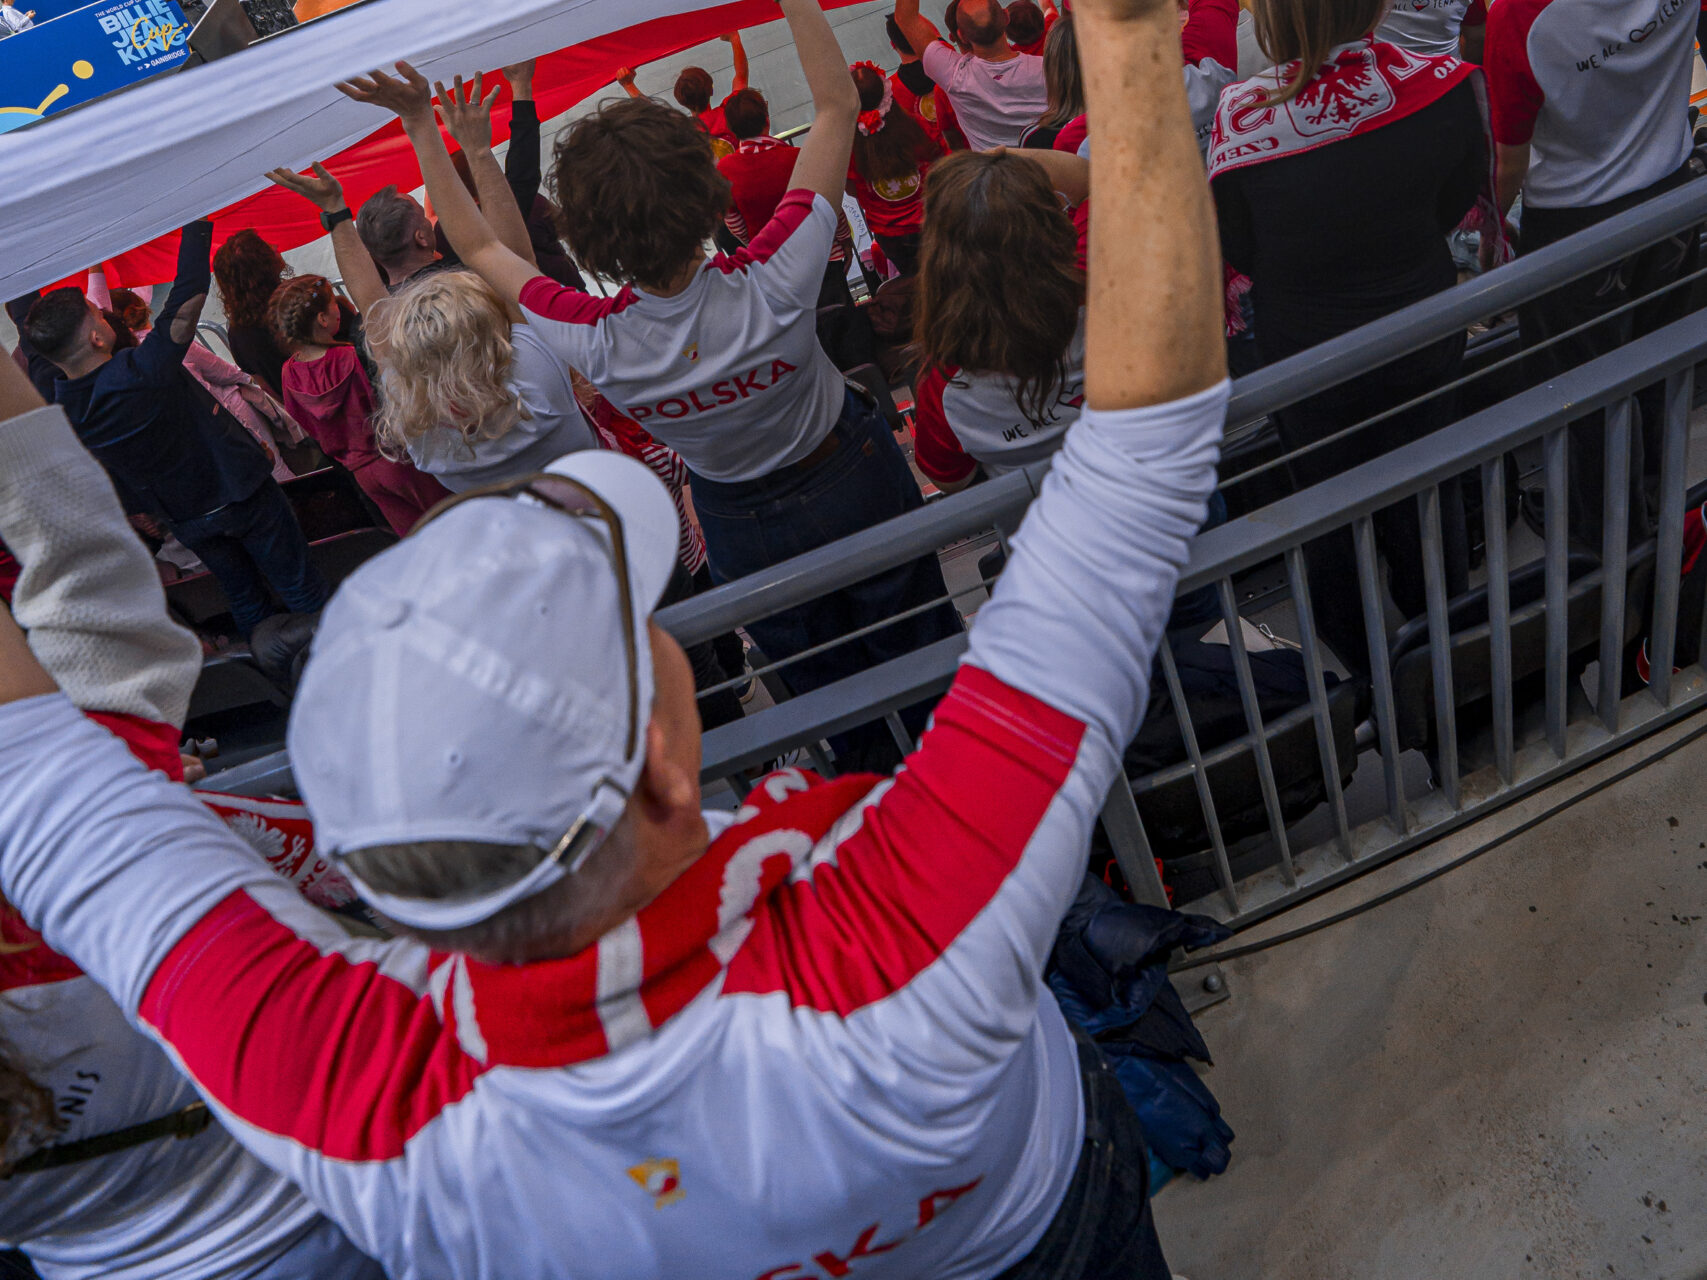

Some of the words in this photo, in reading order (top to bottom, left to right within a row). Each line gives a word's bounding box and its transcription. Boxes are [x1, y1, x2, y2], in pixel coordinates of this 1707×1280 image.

[105, 4, 124, 14] WORLD
[112, 11, 180, 48] JEAN
[131, 16, 188, 51] Cup
[117, 28, 186, 66] KING
[151, 49, 187, 67] GAINBRIDGE
[1576, 54, 1600, 72] WE
[627, 359, 798, 421] POLSKA
[1002, 423, 1028, 442] WE
